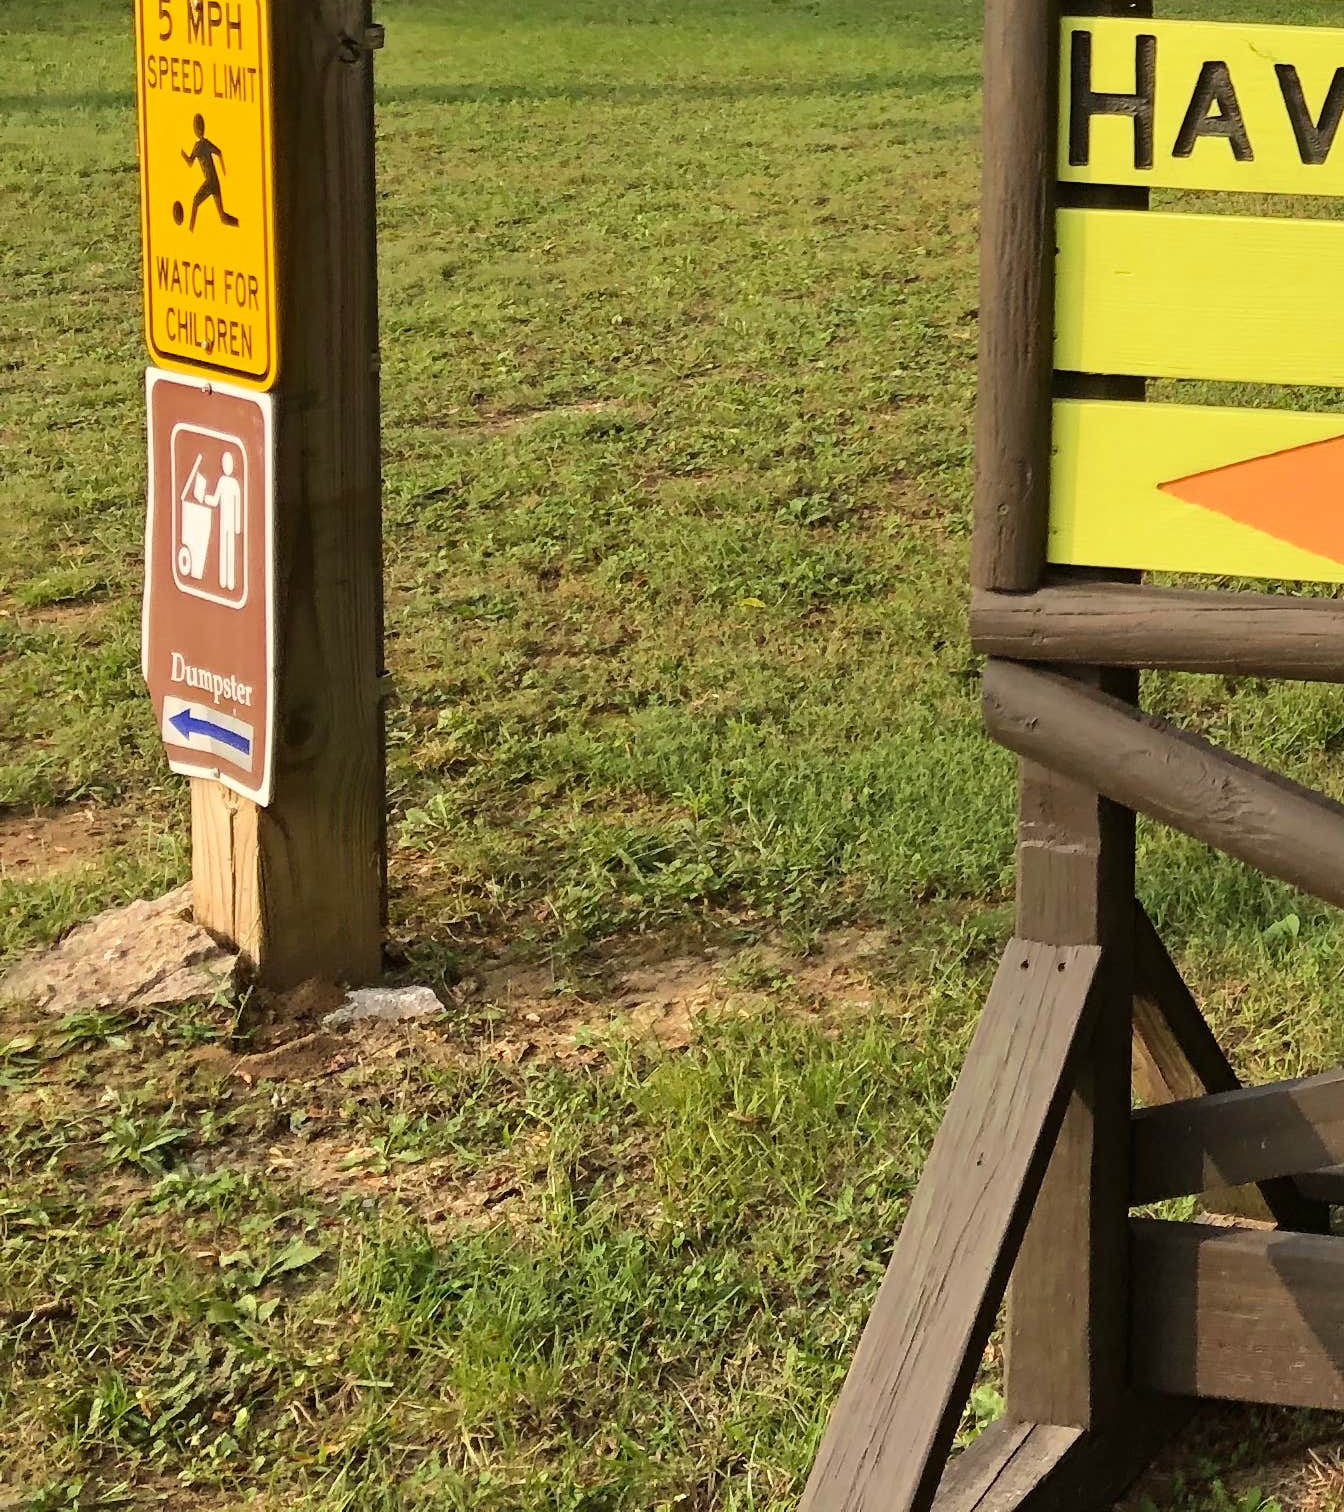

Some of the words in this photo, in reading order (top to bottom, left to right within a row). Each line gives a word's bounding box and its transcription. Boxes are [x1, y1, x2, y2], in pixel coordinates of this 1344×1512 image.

[147, 54, 203, 95] SPEED
[213, 64, 257, 103] LIMIT
[156, 255, 215, 297] WATCH
[224, 270, 259, 311] FOR
[166, 307, 252, 360] CHILDREN
[170, 652, 253, 707] Dumpster
